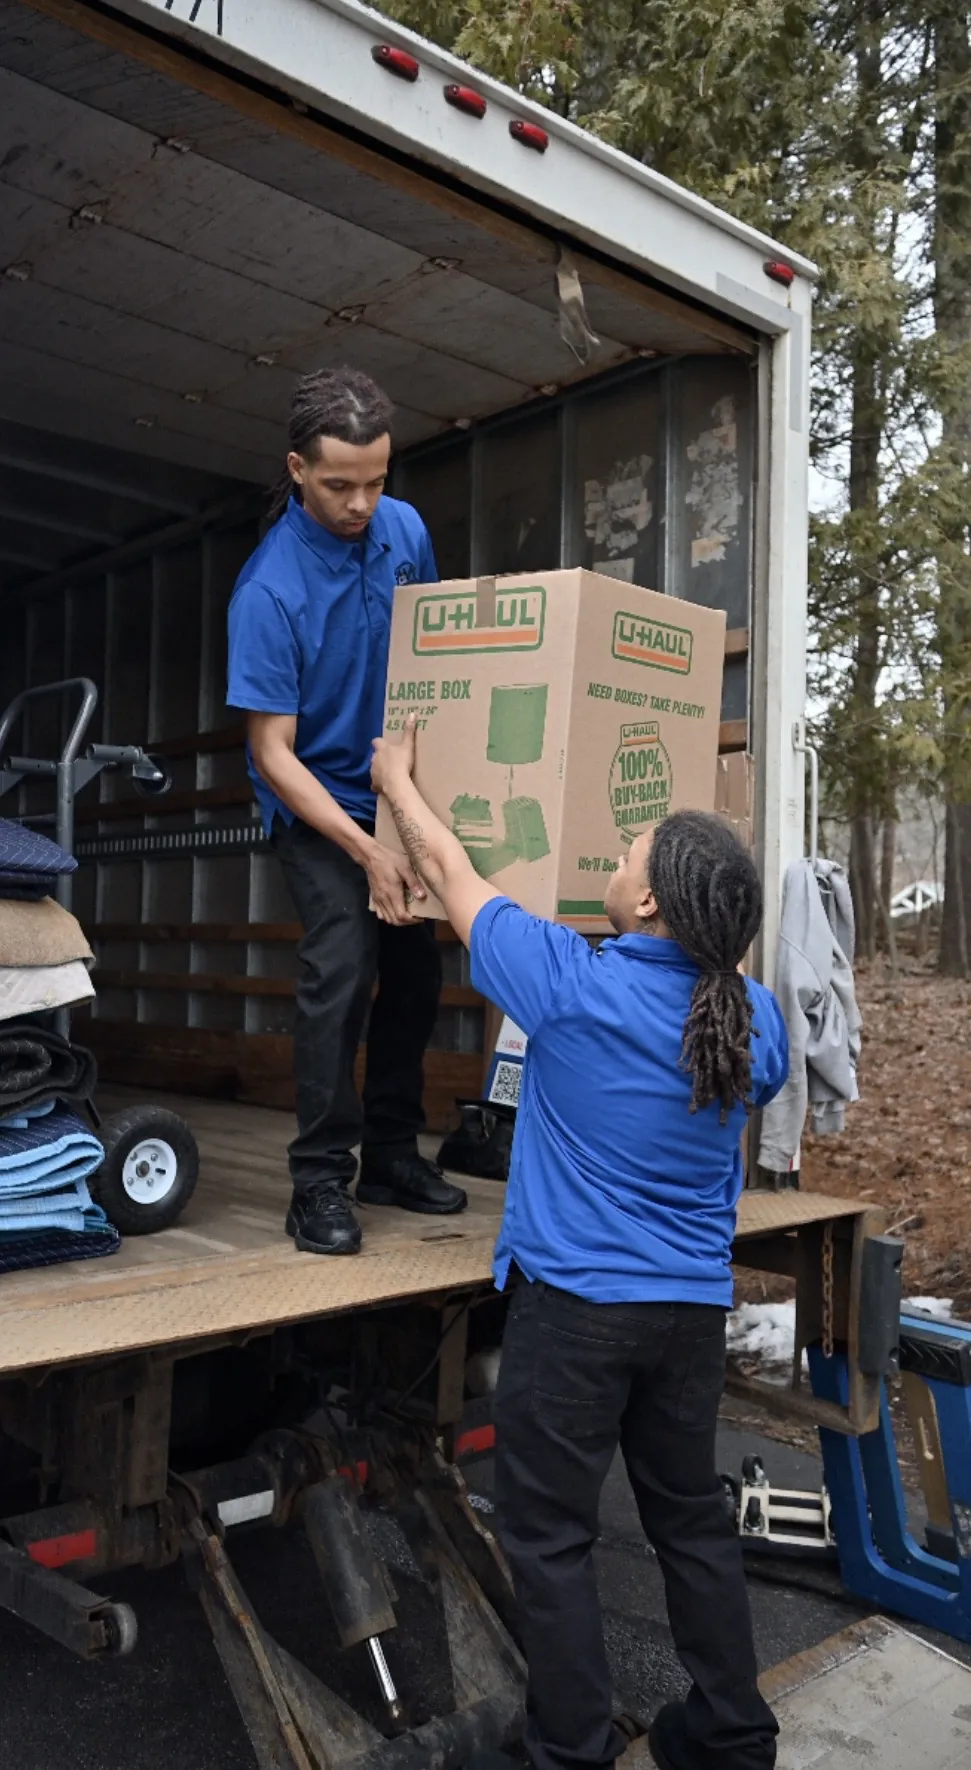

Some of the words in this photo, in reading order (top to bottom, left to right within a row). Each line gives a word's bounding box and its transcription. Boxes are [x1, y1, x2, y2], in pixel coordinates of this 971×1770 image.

[422, 599, 536, 632] U-HUL
[618, 620, 688, 656] U-HAUL
[388, 681, 435, 700] LARGE
[440, 680, 472, 700] BOX
[587, 682, 612, 700] NEED
[614, 688, 648, 708] BOXES?
[650, 695, 672, 713] TAKE
[672, 701, 706, 719] PLENTY!
[623, 724, 657, 738] U-HAUL
[618, 748, 663, 782] 100%
[614, 780, 668, 806] BUY-BACK
[615, 802, 669, 827] GUARANTEE
